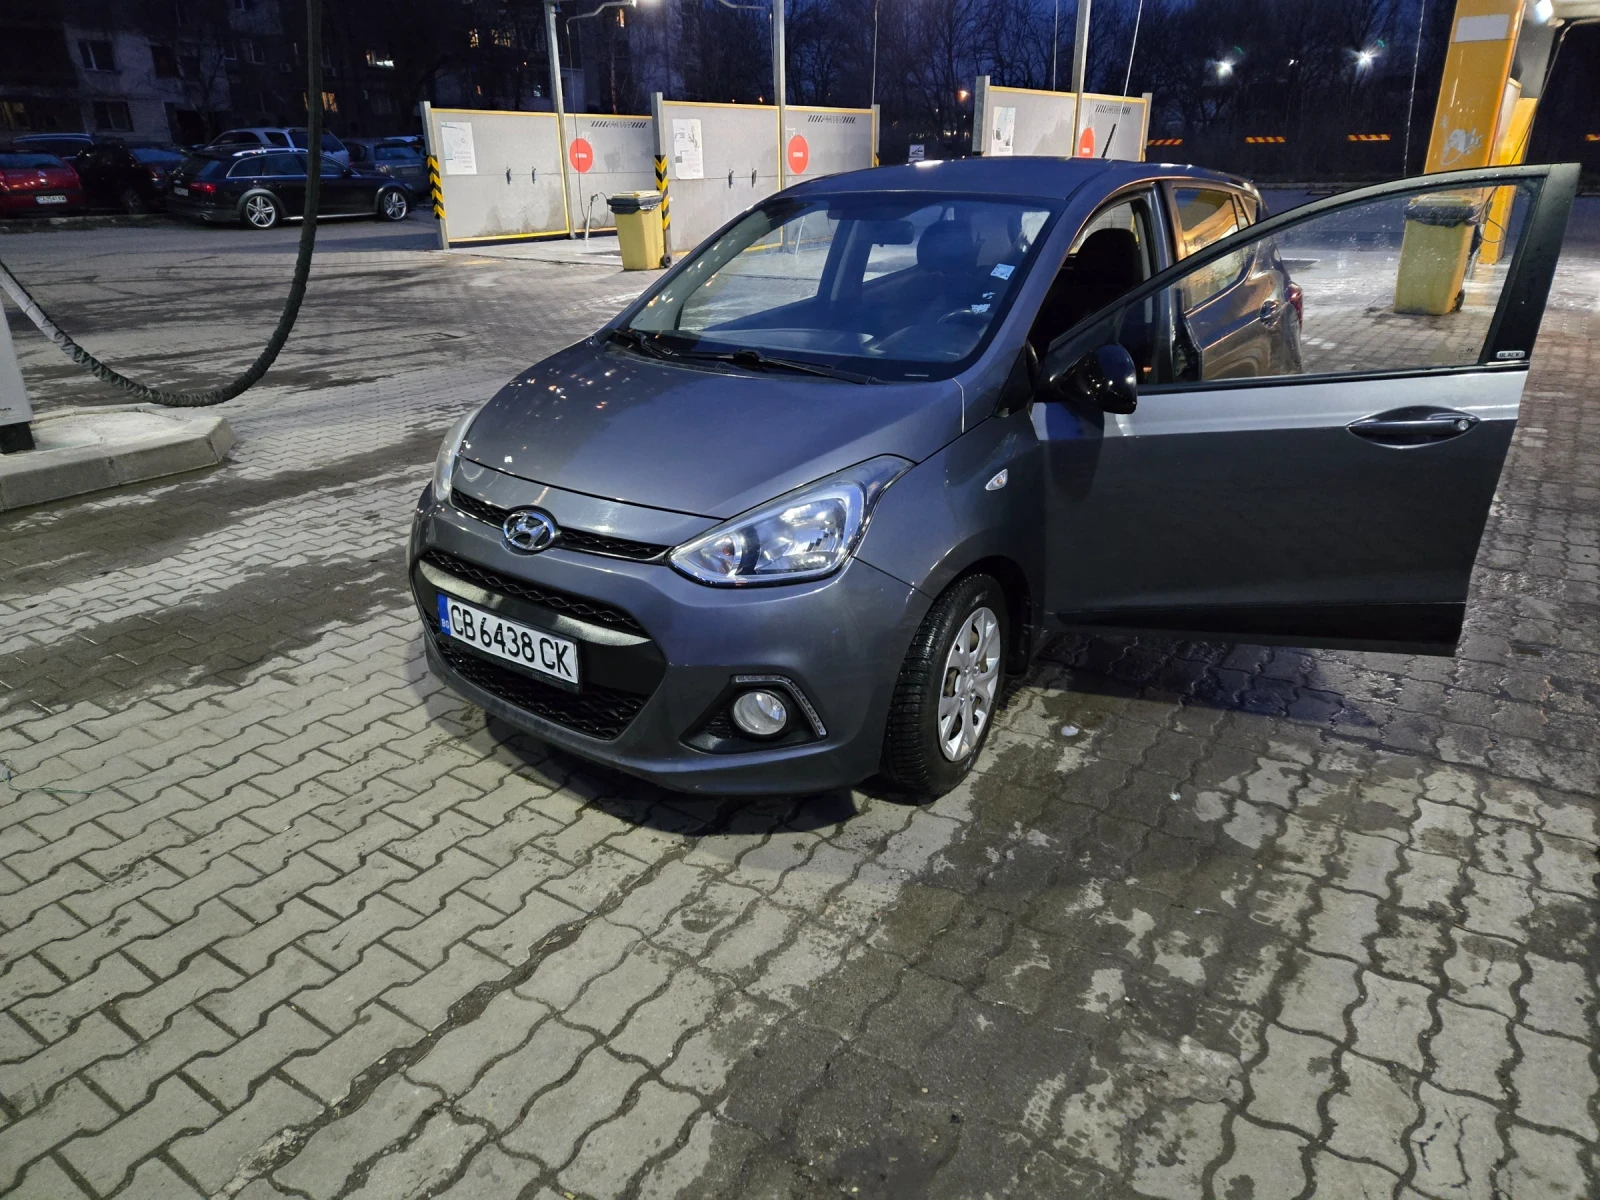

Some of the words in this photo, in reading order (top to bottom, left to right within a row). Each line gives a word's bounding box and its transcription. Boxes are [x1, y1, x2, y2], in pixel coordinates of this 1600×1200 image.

[441, 618, 450, 629] BG
[451, 604, 476, 641] CB
[480, 617, 535, 663] 6438
[539, 637, 573, 678] CK
